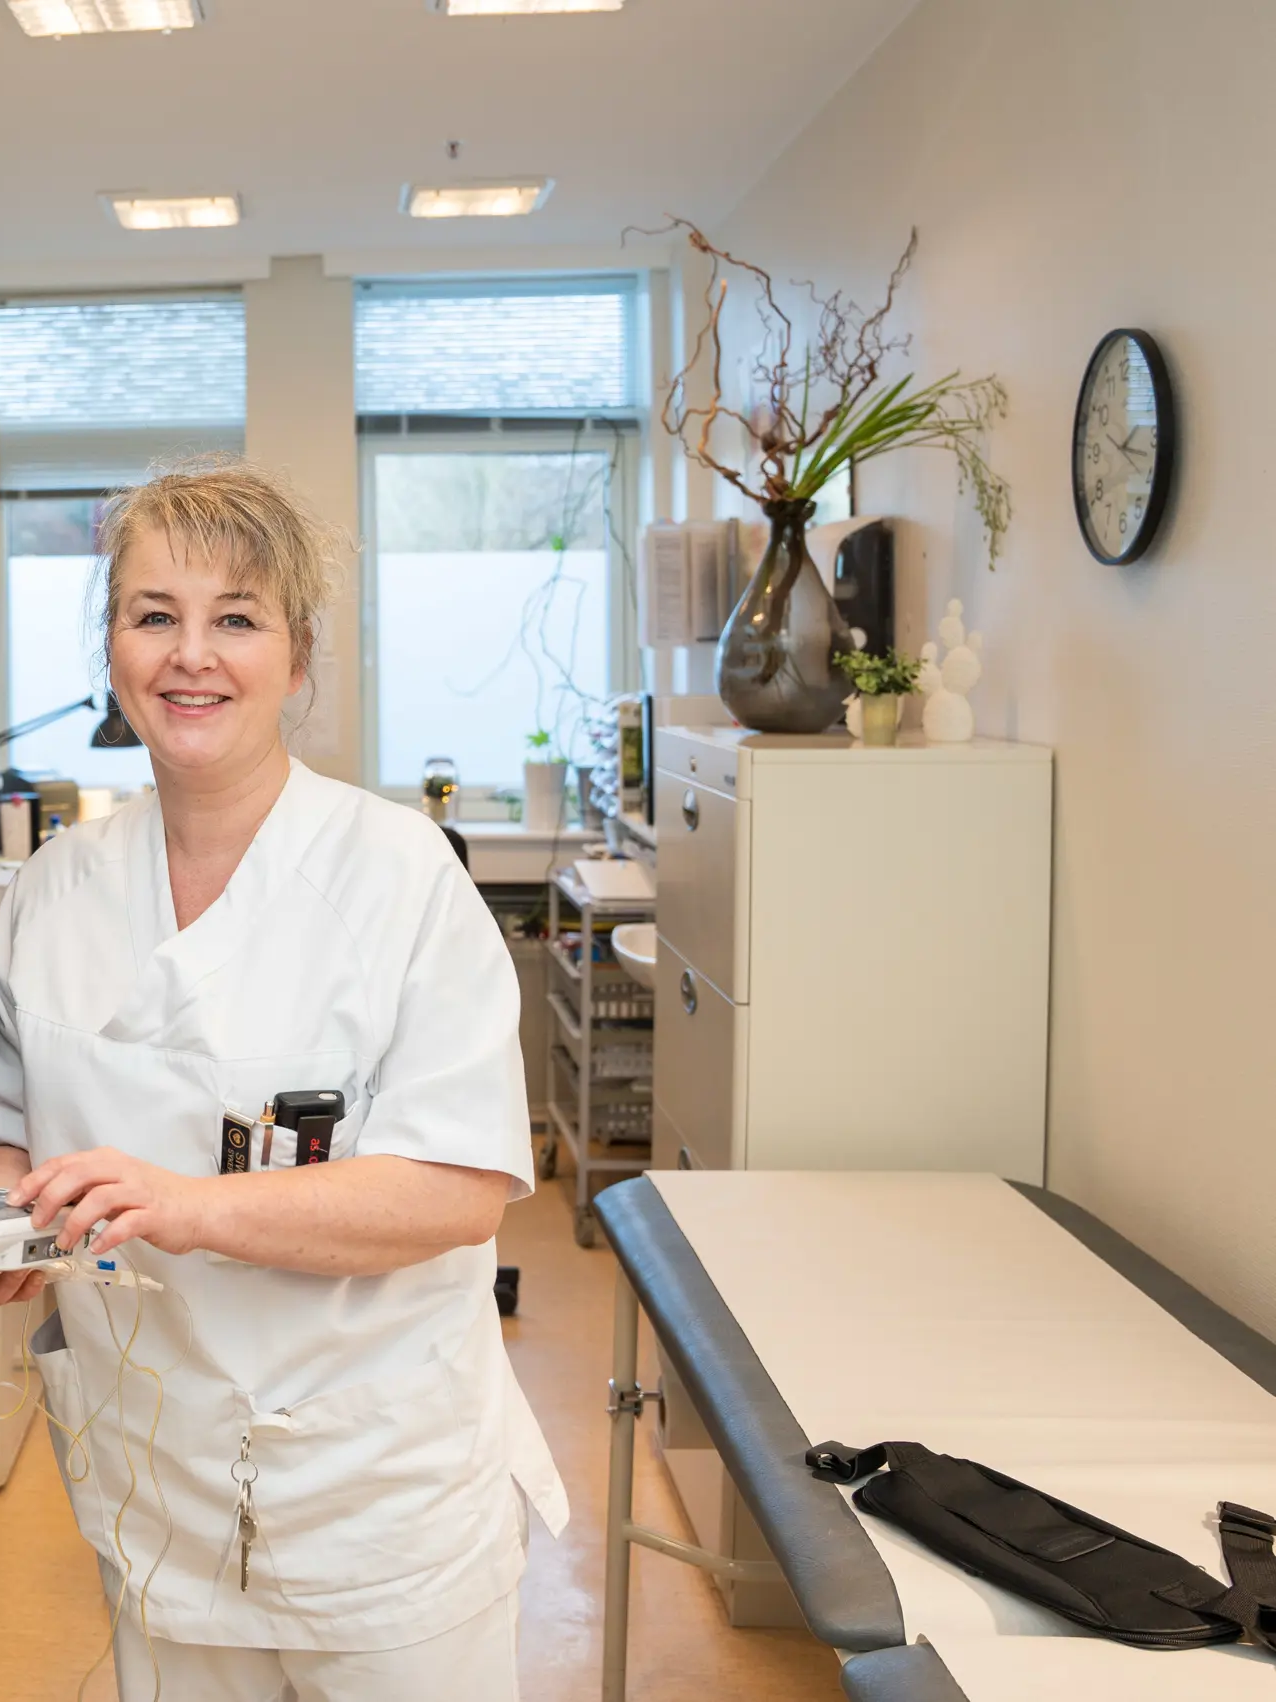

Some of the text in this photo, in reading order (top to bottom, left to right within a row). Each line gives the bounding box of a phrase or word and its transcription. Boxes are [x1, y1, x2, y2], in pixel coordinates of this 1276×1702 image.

[1092, 442, 1101, 464] 9
[1095, 478, 1104, 501] 8
[1105, 502, 1112, 526] 7
[1134, 496, 1143, 520] 5
[1119, 511, 1128, 534] 6
